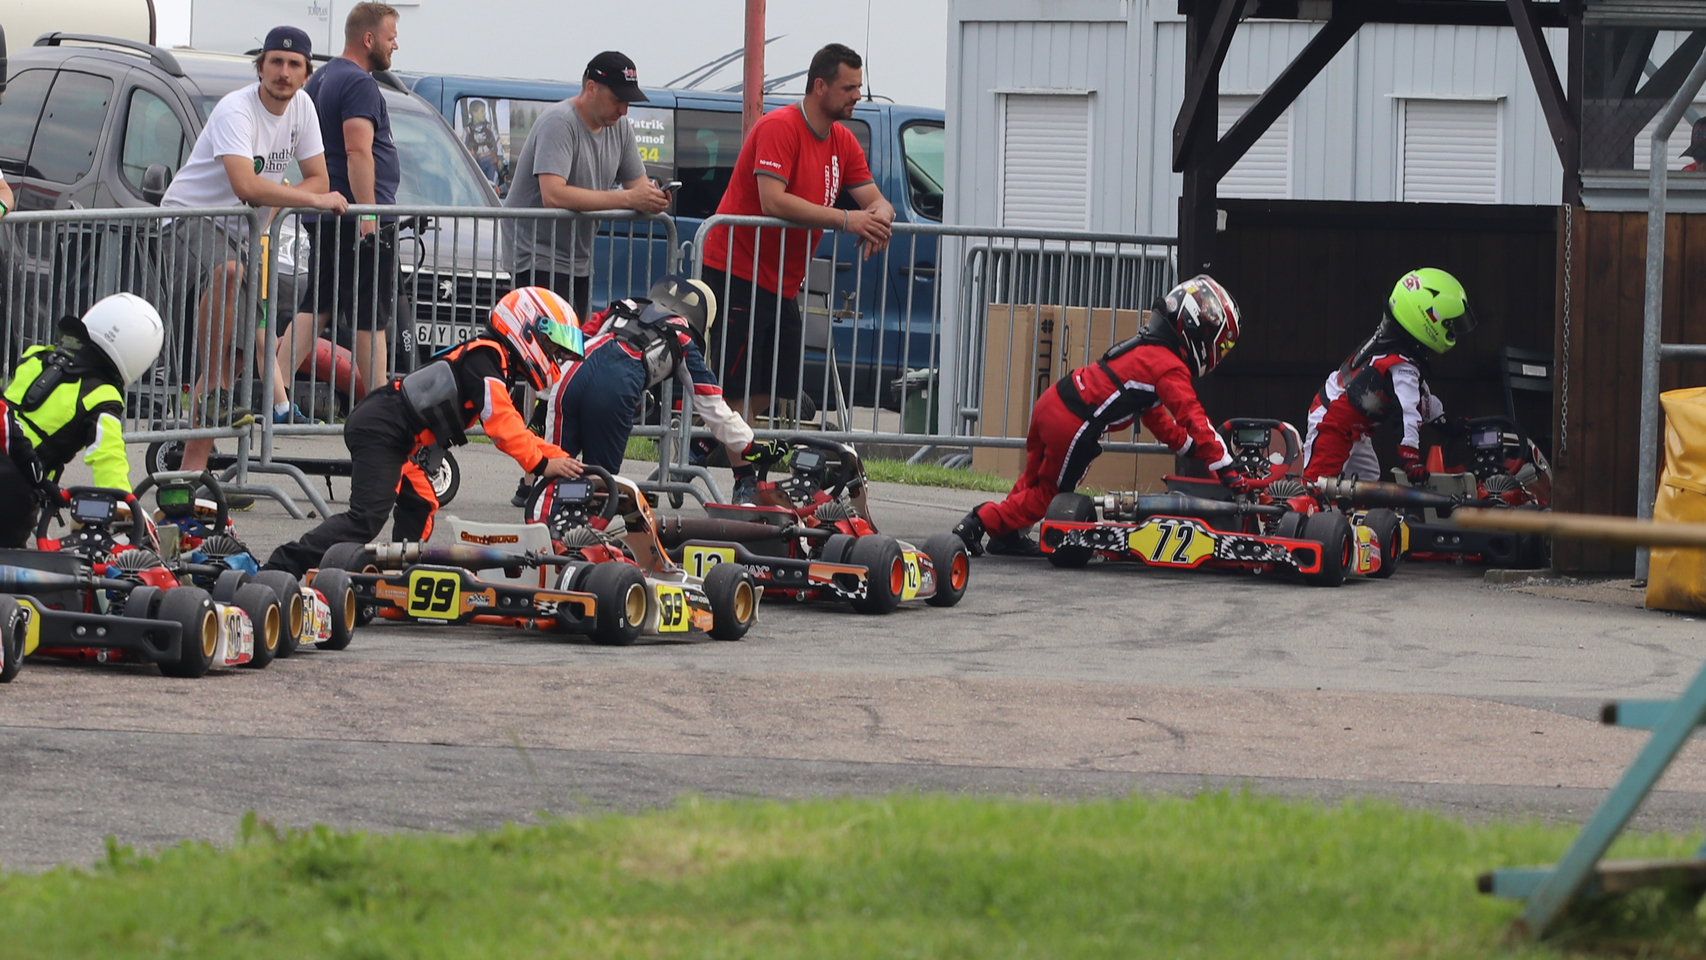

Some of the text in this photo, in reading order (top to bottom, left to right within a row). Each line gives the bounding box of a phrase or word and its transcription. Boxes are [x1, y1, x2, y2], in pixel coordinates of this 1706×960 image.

[829, 155, 839, 208] easyk
[1150, 523, 1196, 564] 72
[411, 577, 456, 612] 99
